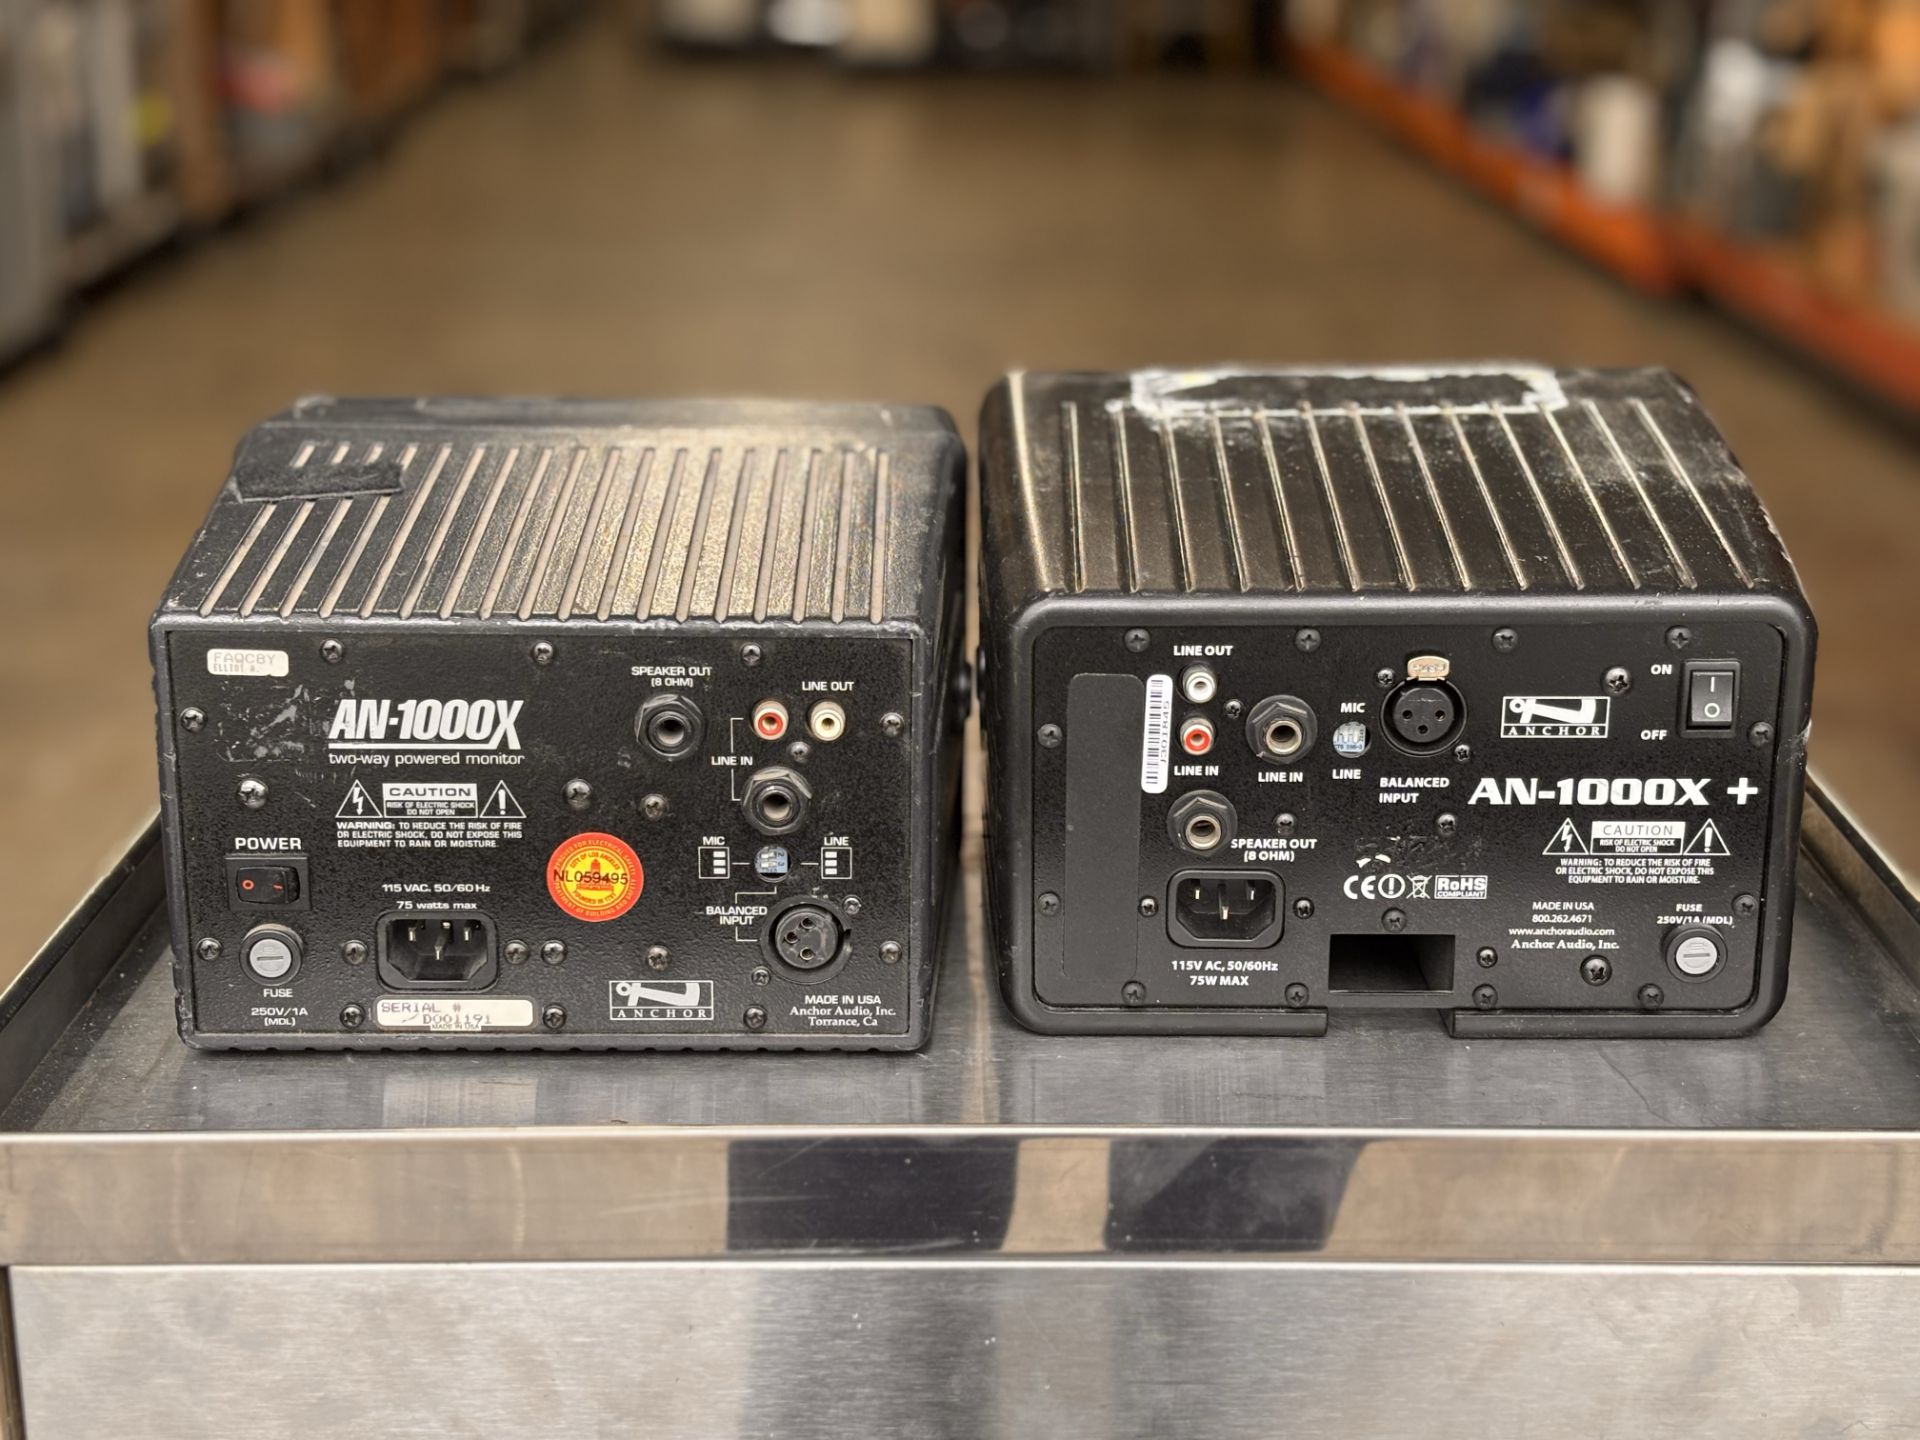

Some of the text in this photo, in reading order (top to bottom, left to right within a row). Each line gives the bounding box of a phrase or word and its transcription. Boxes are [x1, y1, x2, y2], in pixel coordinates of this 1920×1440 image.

[1174, 645, 1233, 656] LINE OUT
[631, 666, 712, 676] SPEAKER OUT
[1651, 665, 1672, 675] ON
[651, 677, 694, 687] (8 OHM)
[802, 681, 854, 691] LINE OUT
[1341, 703, 1365, 713] MIC
[328, 699, 524, 749] AN-1000X
[1508, 726, 1600, 735] ANCHOR
[1641, 730, 1667, 740] OFF
[329, 752, 525, 767] two-way powered monitor
[712, 756, 753, 766] LINE IN
[1174, 766, 1219, 776] LINE IN
[1332, 769, 1361, 779] LINE
[1258, 772, 1303, 782] LINE IN
[1380, 778, 1449, 789] BALANCED
[390, 787, 471, 797] CAUTION
[1467, 777, 1711, 806] AN-1000X
[1379, 793, 1418, 804] INPUT
[337, 830, 349, 838] OR
[352, 830, 392, 838] ELECTRIC
[431, 830, 443, 838] DO
[446, 830, 464, 838] NOT
[466, 830, 500, 838] EXPOSE
[502, 830, 522, 838] THIS
[1603, 824, 1673, 836] CAUTION
[235, 838, 302, 850] POWER
[337, 839, 499, 848] EQUIPMENT TO RAIN OR MOISTURE.
[703, 836, 725, 845] MIC
[824, 836, 849, 846] LINE
[1231, 839, 1317, 849] SPEAKER OUT
[1244, 850, 1295, 862] (8 OHM)
[1568, 867, 1602, 875] ELECTRIC
[1605, 867, 1633, 875] SHOCK,
[1635, 867, 1647, 875] DO
[1649, 867, 1665, 875] NOT
[1667, 867, 1696, 875] EXPOSE
[1697, 867, 1714, 875] THIS
[554, 870, 628, 885] NL059495
[1568, 876, 1614, 884] EQUIPMENT
[1659, 876, 1701, 884] MOISTURE.
[382, 884, 401, 893] 115
[434, 883, 474, 893] 50/60
[475, 884, 490, 893] Hz
[1437, 877, 1486, 891] RoHS
[396, 901, 477, 909] 75 watts max
[1532, 902, 1594, 911] MADE IN USA
[1676, 904, 1702, 912] FUSE
[706, 906, 767, 916] BALANCED
[719, 916, 754, 925] INPUT
[1532, 914, 1592, 923] 800.262.4671
[1657, 915, 1733, 925] 250V/1A (MDL)
[1509, 926, 1615, 936] www.anchoraudio.com
[1511, 939, 1620, 951] Anchor Audio, Inc.
[1171, 960, 1278, 972] 115V AC, 50/60Hz
[1190, 976, 1249, 986] 75W MAX
[264, 988, 293, 998] FUSE
[805, 995, 881, 1004] MADE IN USA
[251, 1007, 308, 1016] 250V/1A
[382, 1002, 441, 1012] SERIAL
[790, 1006, 896, 1017] Anchor Audio, Inc.
[617, 1009, 707, 1018] ANCHOR
[264, 1017, 296, 1027] (MDL)
[808, 1017, 878, 1027] Torrance, Ca
